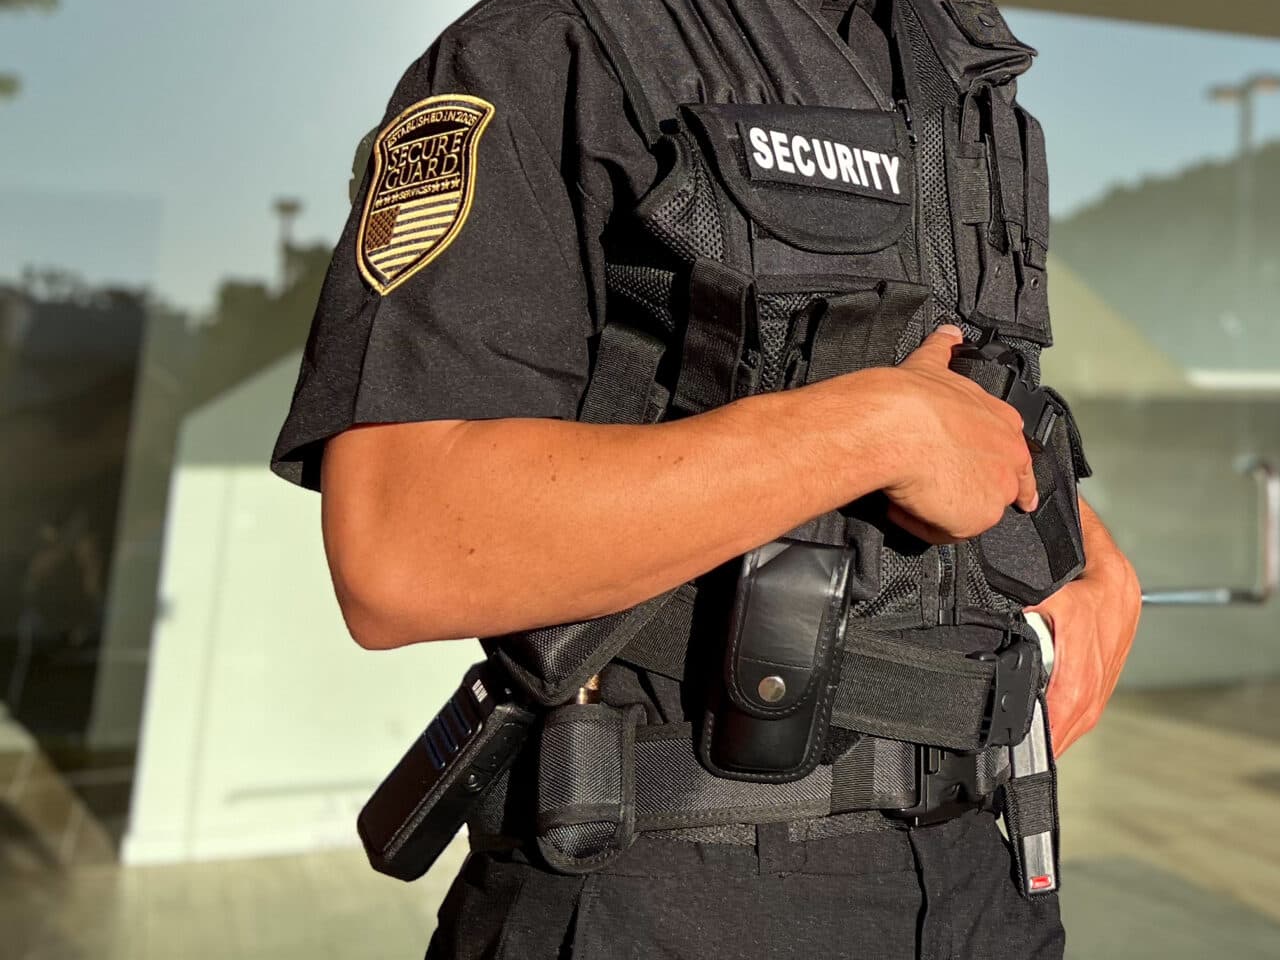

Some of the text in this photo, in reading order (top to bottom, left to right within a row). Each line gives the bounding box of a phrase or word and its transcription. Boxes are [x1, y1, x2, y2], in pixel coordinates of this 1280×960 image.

[387, 112, 443, 148] ESTABLISHED
[388, 132, 463, 171] SECURE
[750, 127, 900, 195] SECURITY
[386, 153, 459, 190] GUARD
